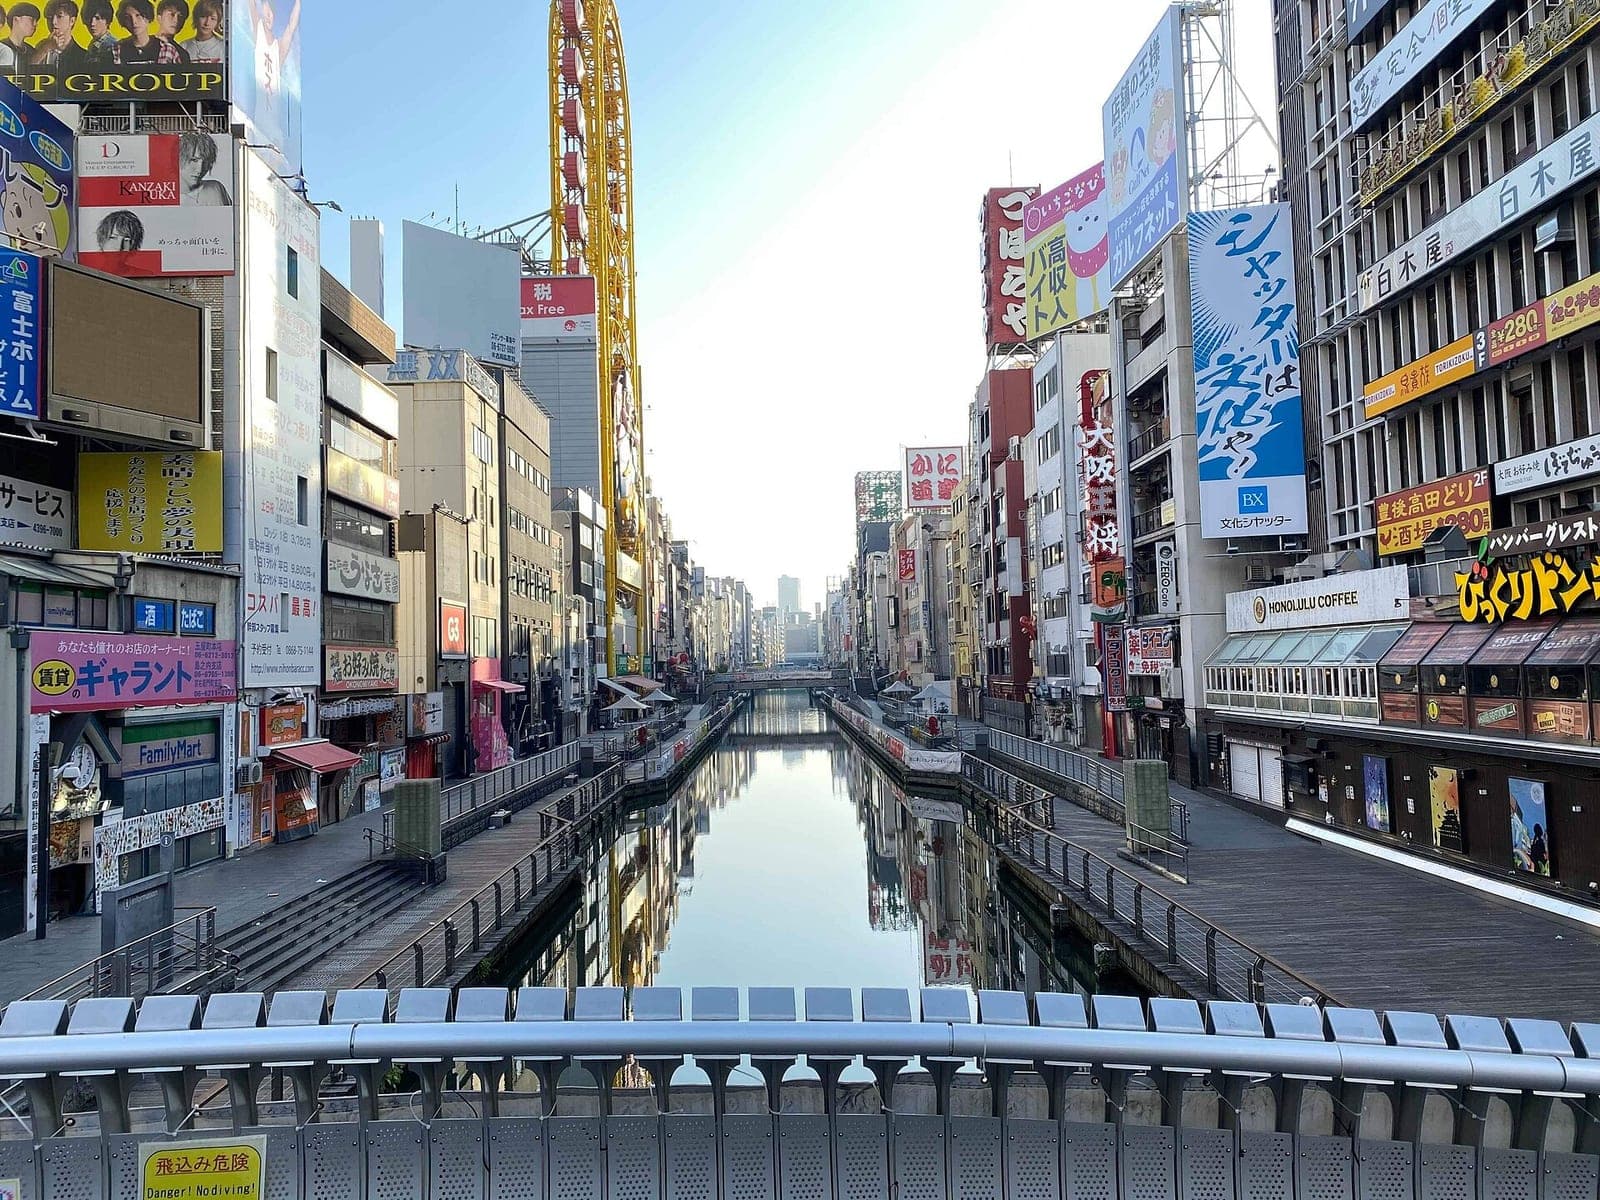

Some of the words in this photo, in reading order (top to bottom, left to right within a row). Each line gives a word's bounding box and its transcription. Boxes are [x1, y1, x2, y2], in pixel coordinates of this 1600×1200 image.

[65, 71, 222, 92] GROUP
[1112, 34, 1160, 126] 店舗の王様
[119, 180, 176, 196] KANZAKI
[1041, 166, 1104, 217] いちごなび
[1500, 131, 1596, 221] 白木屋
[141, 190, 176, 204] RUKA
[158, 237, 220, 246] めっちゃ面白いを
[1113, 190, 1175, 277] ガルフネット
[202, 247, 227, 255] 仕事に。
[1359, 269, 1373, 290] 4F
[1377, 231, 1444, 298] 白木屋
[534, 283, 552, 301] 税
[1029, 242, 1048, 332] バイト
[1047, 234, 1069, 325] 高収入
[537, 303, 565, 315] Free
[1215, 209, 1298, 397] シャッターは
[11, 289, 34, 411] 富士ホーム
[1400, 364, 1431, 397] 鳥貴族
[911, 453, 959, 476] かに
[0, 483, 65, 519] サービス
[128, 456, 146, 544] あなたのお店づくり
[161, 454, 195, 550] 素晴らしい夢の実現
[1079, 421, 1119, 554] 大阪王将
[1243, 493, 1265, 507] BX
[1377, 479, 1474, 522] 豊後高田どり
[1473, 471, 1488, 488] 2F
[105, 489, 123, 538] 応援します
[1392, 518, 1434, 547] 酒場
[1489, 516, 1599, 551] ハンバーグレスト
[145, 604, 156, 627] 酒
[1268, 595, 1316, 614] HONOLULU
[1318, 590, 1358, 609] COFFEE
[181, 608, 204, 628] たばこ
[1107, 641, 1122, 678] ダイコク
[1128, 631, 1140, 657] 薬
[38, 668, 70, 687] 賃貸
[71, 689, 81, 699] の
[77, 657, 193, 697] ギャラント
[342, 650, 379, 678] お好み焼
[1141, 660, 1160, 674] 免税
[140, 739, 202, 765] FamilyMart
[155, 1153, 250, 1176] 飛込み危険
[147, 1186, 192, 1199] Danger!
